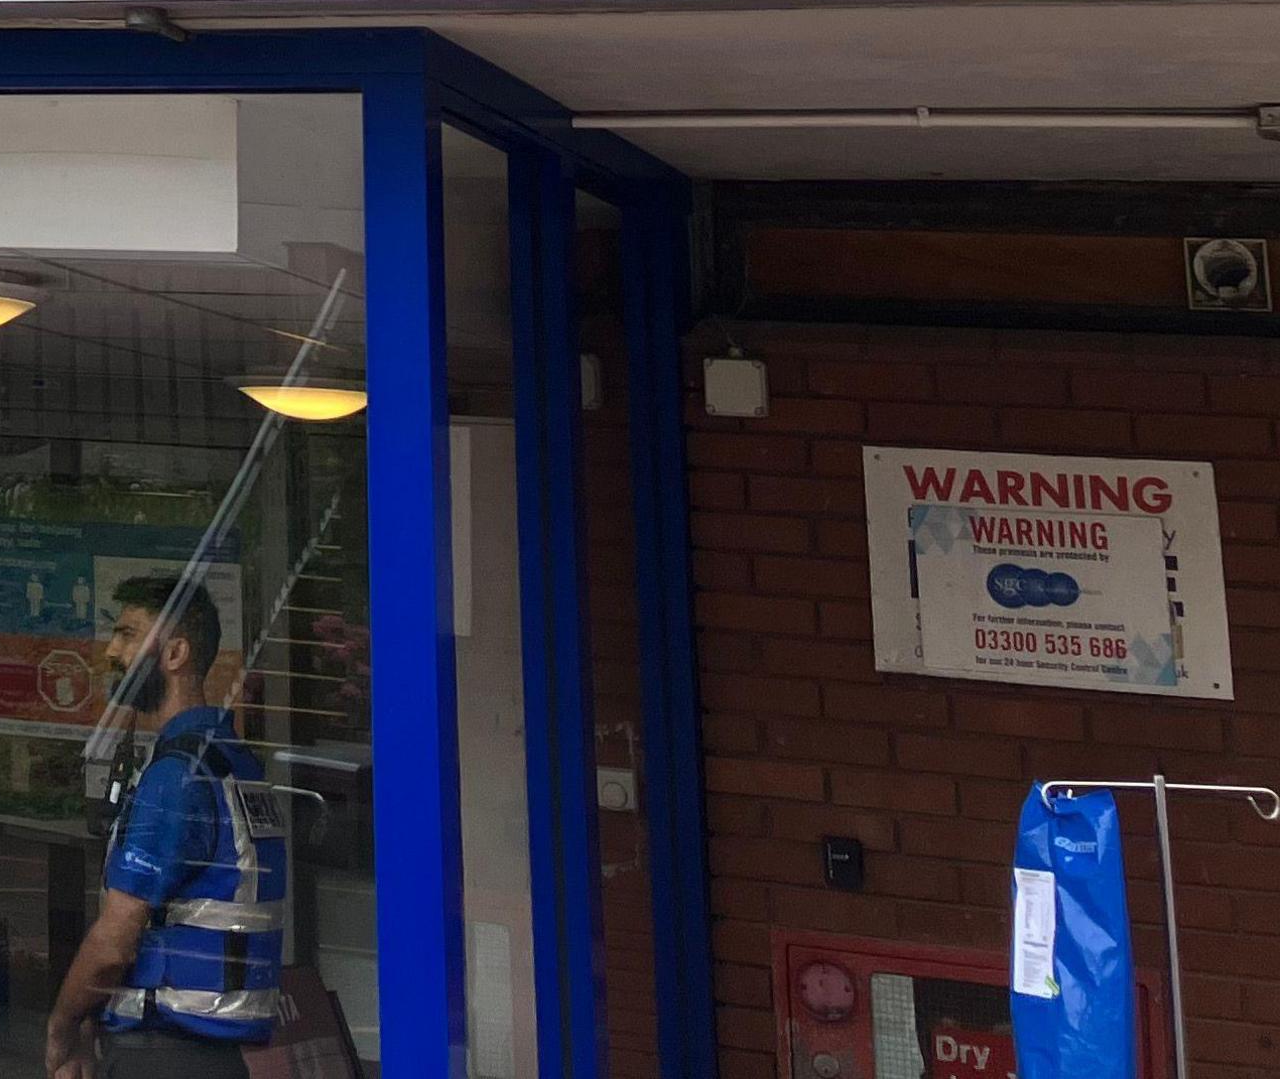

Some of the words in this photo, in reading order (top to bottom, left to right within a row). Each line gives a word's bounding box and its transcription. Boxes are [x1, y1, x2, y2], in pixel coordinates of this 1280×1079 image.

[903, 465, 1172, 514] WARNING
[968, 515, 1109, 551] WARNING
[975, 628, 1037, 653] 03300
[1045, 634, 1082, 656] 535
[1089, 637, 1127, 659] 686
[935, 1035, 991, 1071] Dry
